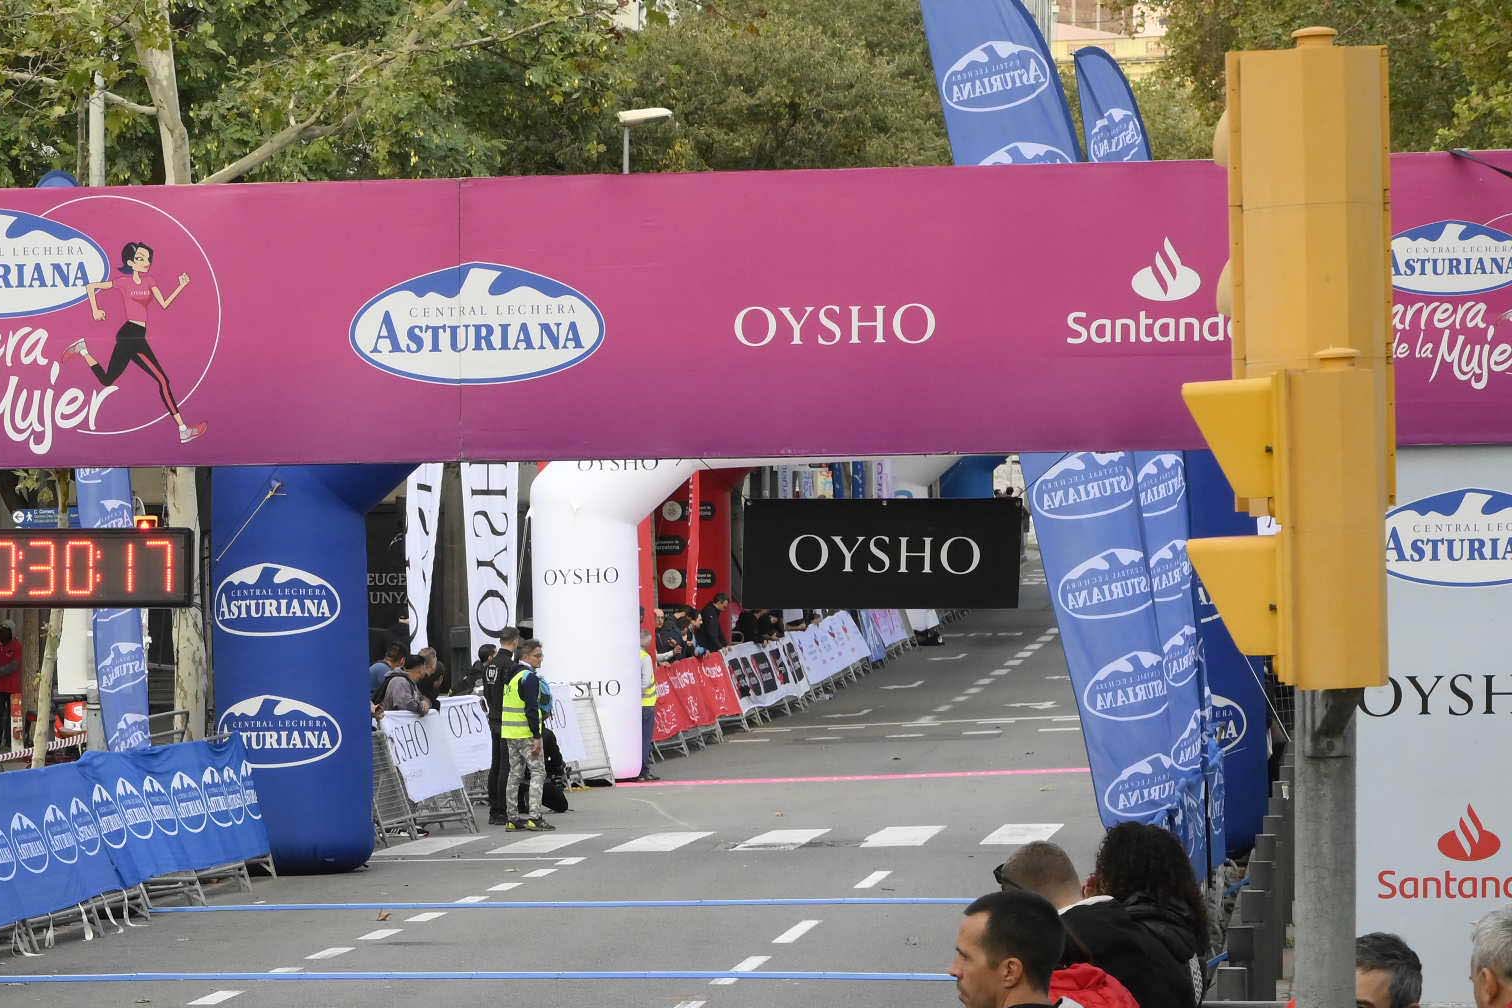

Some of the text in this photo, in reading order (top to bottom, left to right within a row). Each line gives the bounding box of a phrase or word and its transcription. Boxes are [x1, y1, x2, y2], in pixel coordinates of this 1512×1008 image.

[13, 245, 84, 257] LECHERA
[409, 303, 576, 318] CENTRAL LECHERA
[369, 309, 584, 354] ASTURIANA
[733, 303, 936, 347] OYSHO
[1415, 330, 1433, 358] la
[1429, 325, 1512, 389] Muje
[1413, 523, 1479, 533] CENTRAL
[788, 534, 981, 576] OYSHO
[544, 566, 619, 586] OYSHO
[231, 588, 326, 597] CENTRAL LECHERA
[219, 593, 331, 621] ASTURIANA
[574, 679, 621, 698] SHO
[232, 719, 327, 728] CENTRAL LECHERA
